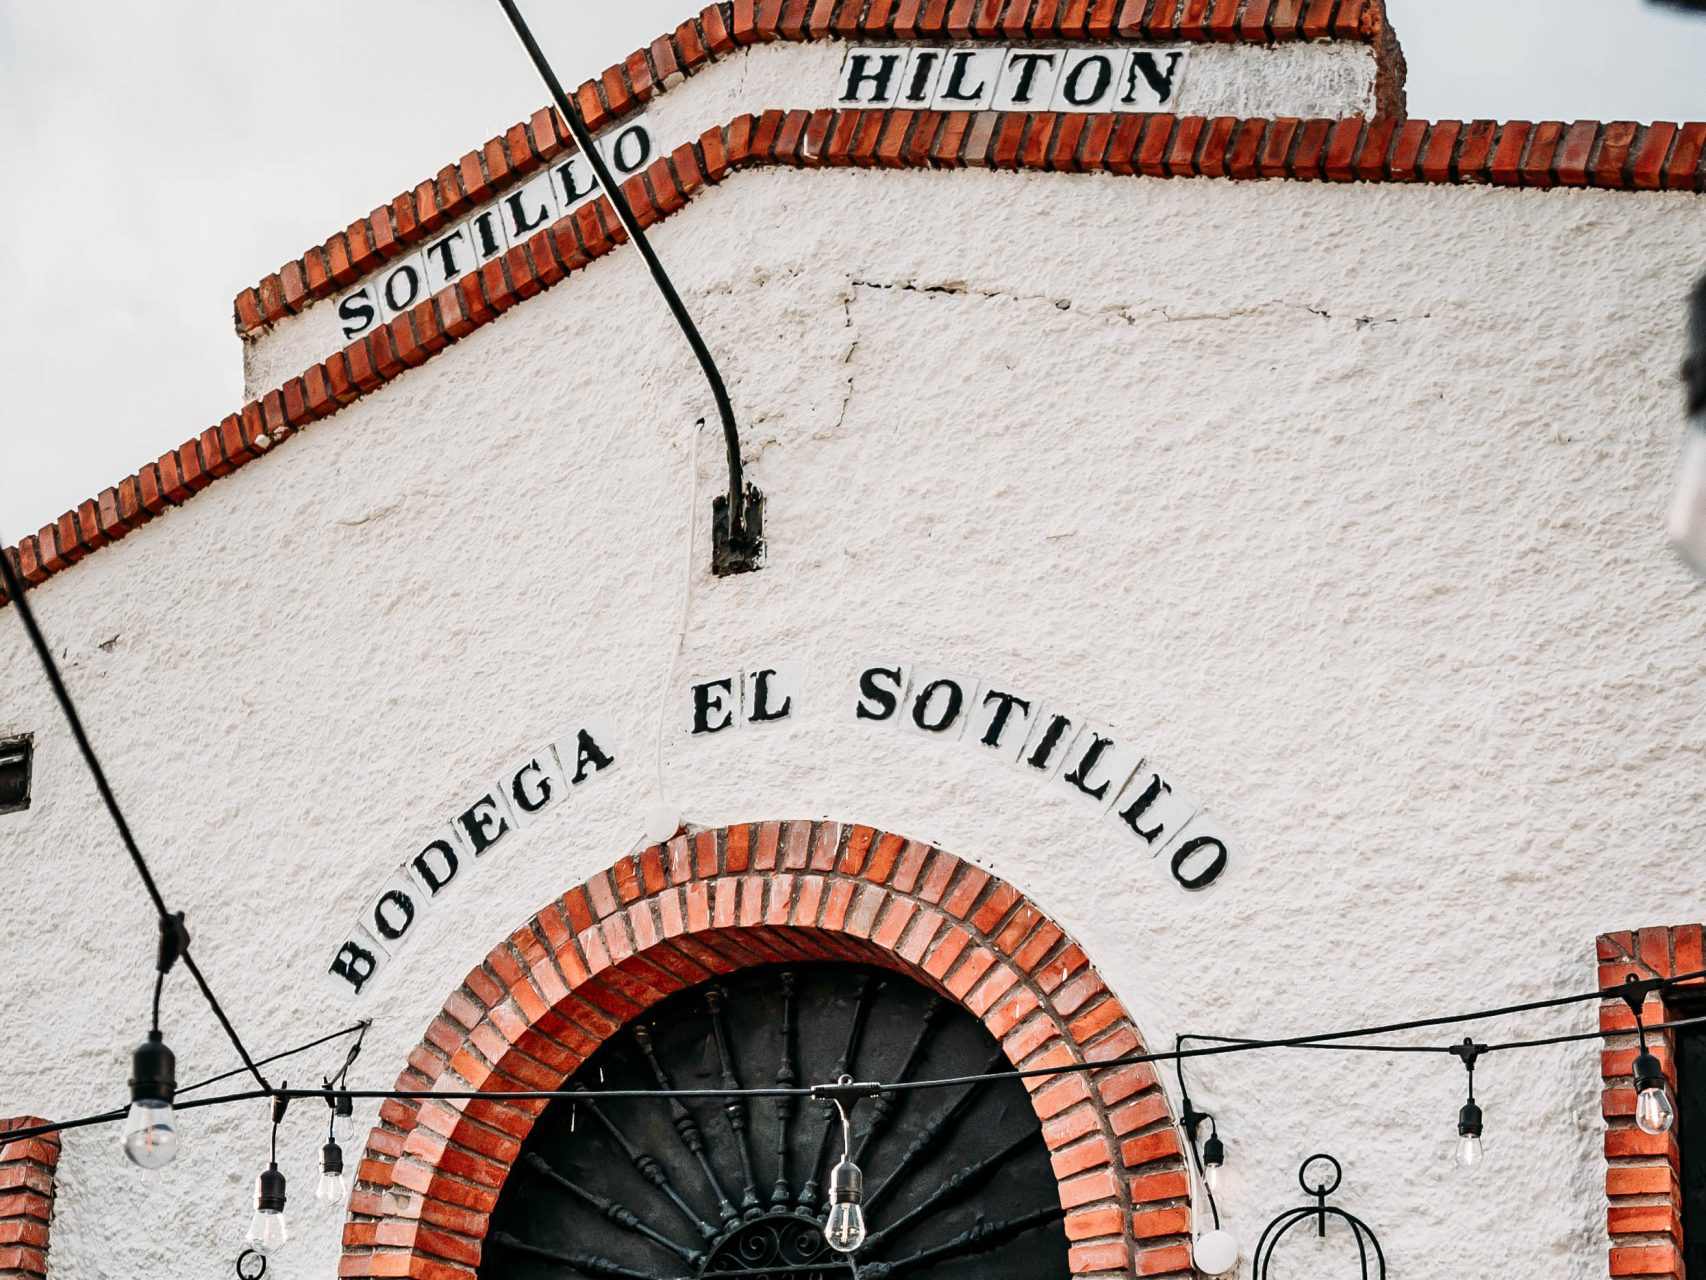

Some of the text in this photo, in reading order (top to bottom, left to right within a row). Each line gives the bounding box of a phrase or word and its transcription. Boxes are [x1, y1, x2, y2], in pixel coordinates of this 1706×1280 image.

[839, 50, 1182, 105] HILTON
[337, 124, 651, 339] SOTILLO
[328, 666, 1229, 994] BODEGA EL SOTILLO
